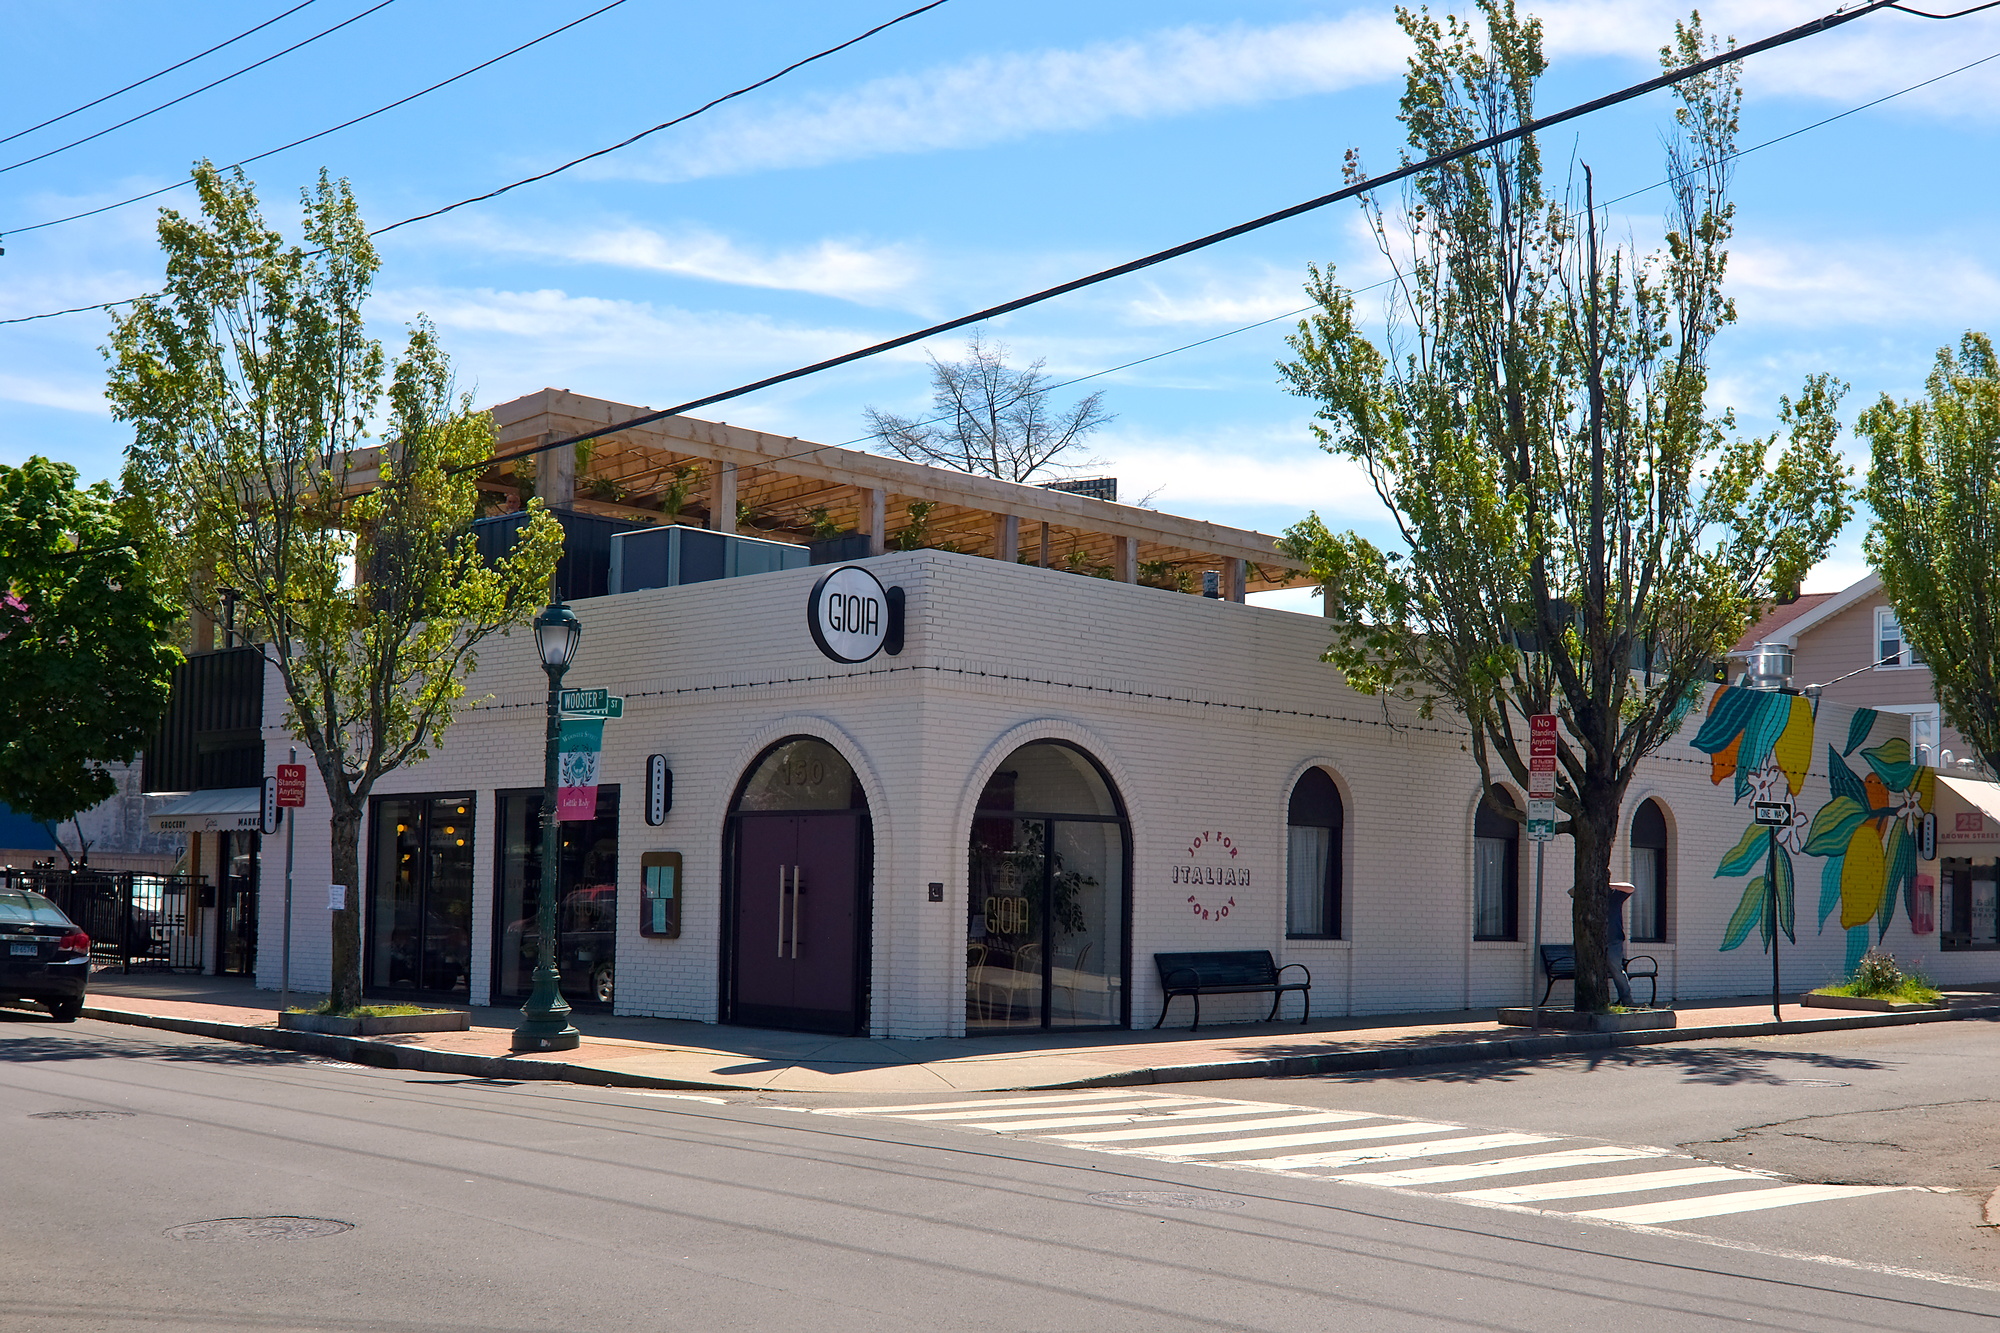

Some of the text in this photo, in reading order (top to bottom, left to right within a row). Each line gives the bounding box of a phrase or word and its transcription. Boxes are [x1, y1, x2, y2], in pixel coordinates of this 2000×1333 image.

[829, 593, 879, 636] GIOIA
[564, 691, 604, 709] WOOSTER ST
[610, 699, 618, 708] ST
[1537, 719, 1550, 728] No
[1531, 729, 1556, 738] Standing
[1531, 738, 1556, 747] Anytime
[284, 769, 299, 778] No
[278, 779, 305, 788] Standing
[279, 787, 304, 797] Anytime
[1761, 808, 1785, 818] ONE WAY
[160, 821, 186, 829] GROCERY
[1957, 815, 1981, 830] 25
[1188, 831, 1238, 859] JOY FOR
[1173, 866, 1250, 886] ITALIAN
[1187, 895, 1235, 921] FOR JOY
[985, 896, 1029, 934] GIOIA
